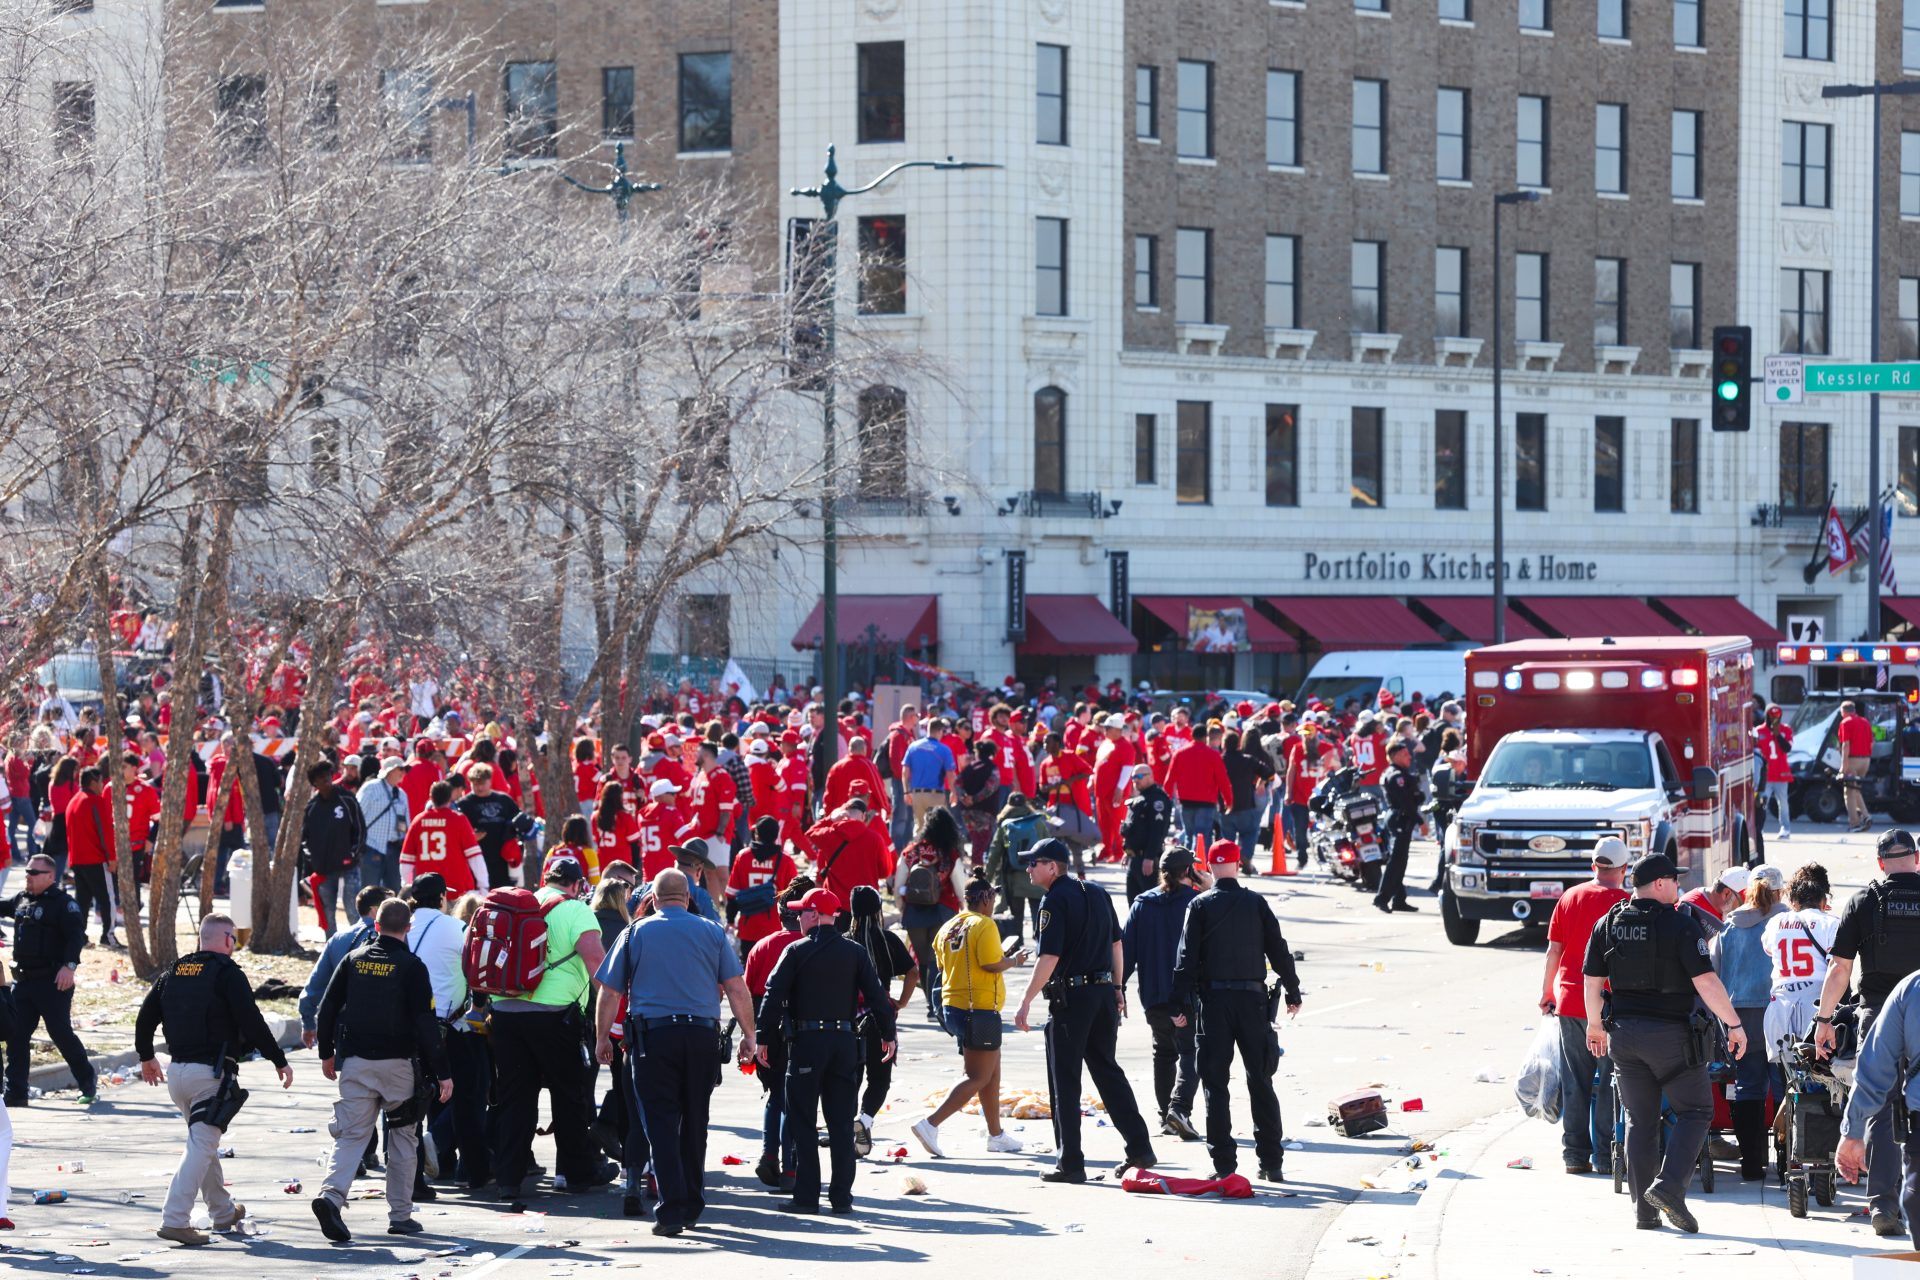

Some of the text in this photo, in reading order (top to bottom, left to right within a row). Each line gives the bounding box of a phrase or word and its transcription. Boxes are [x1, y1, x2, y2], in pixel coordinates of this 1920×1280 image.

[1817, 370, 1910, 385] Kessler Rd
[1304, 552, 1597, 581] Portfolio Kitchen & Home
[1768, 741, 1778, 760] 1
[421, 818, 446, 828] THOMAS
[420, 831, 447, 860] 13
[640, 825, 662, 852] 15
[1778, 920, 1816, 930] MAHOS
[1611, 926, 1647, 940] POLICE
[1778, 938, 1815, 978] 15
[175, 963, 204, 976] SHERIFF
[355, 960, 396, 972] SHERIFF
